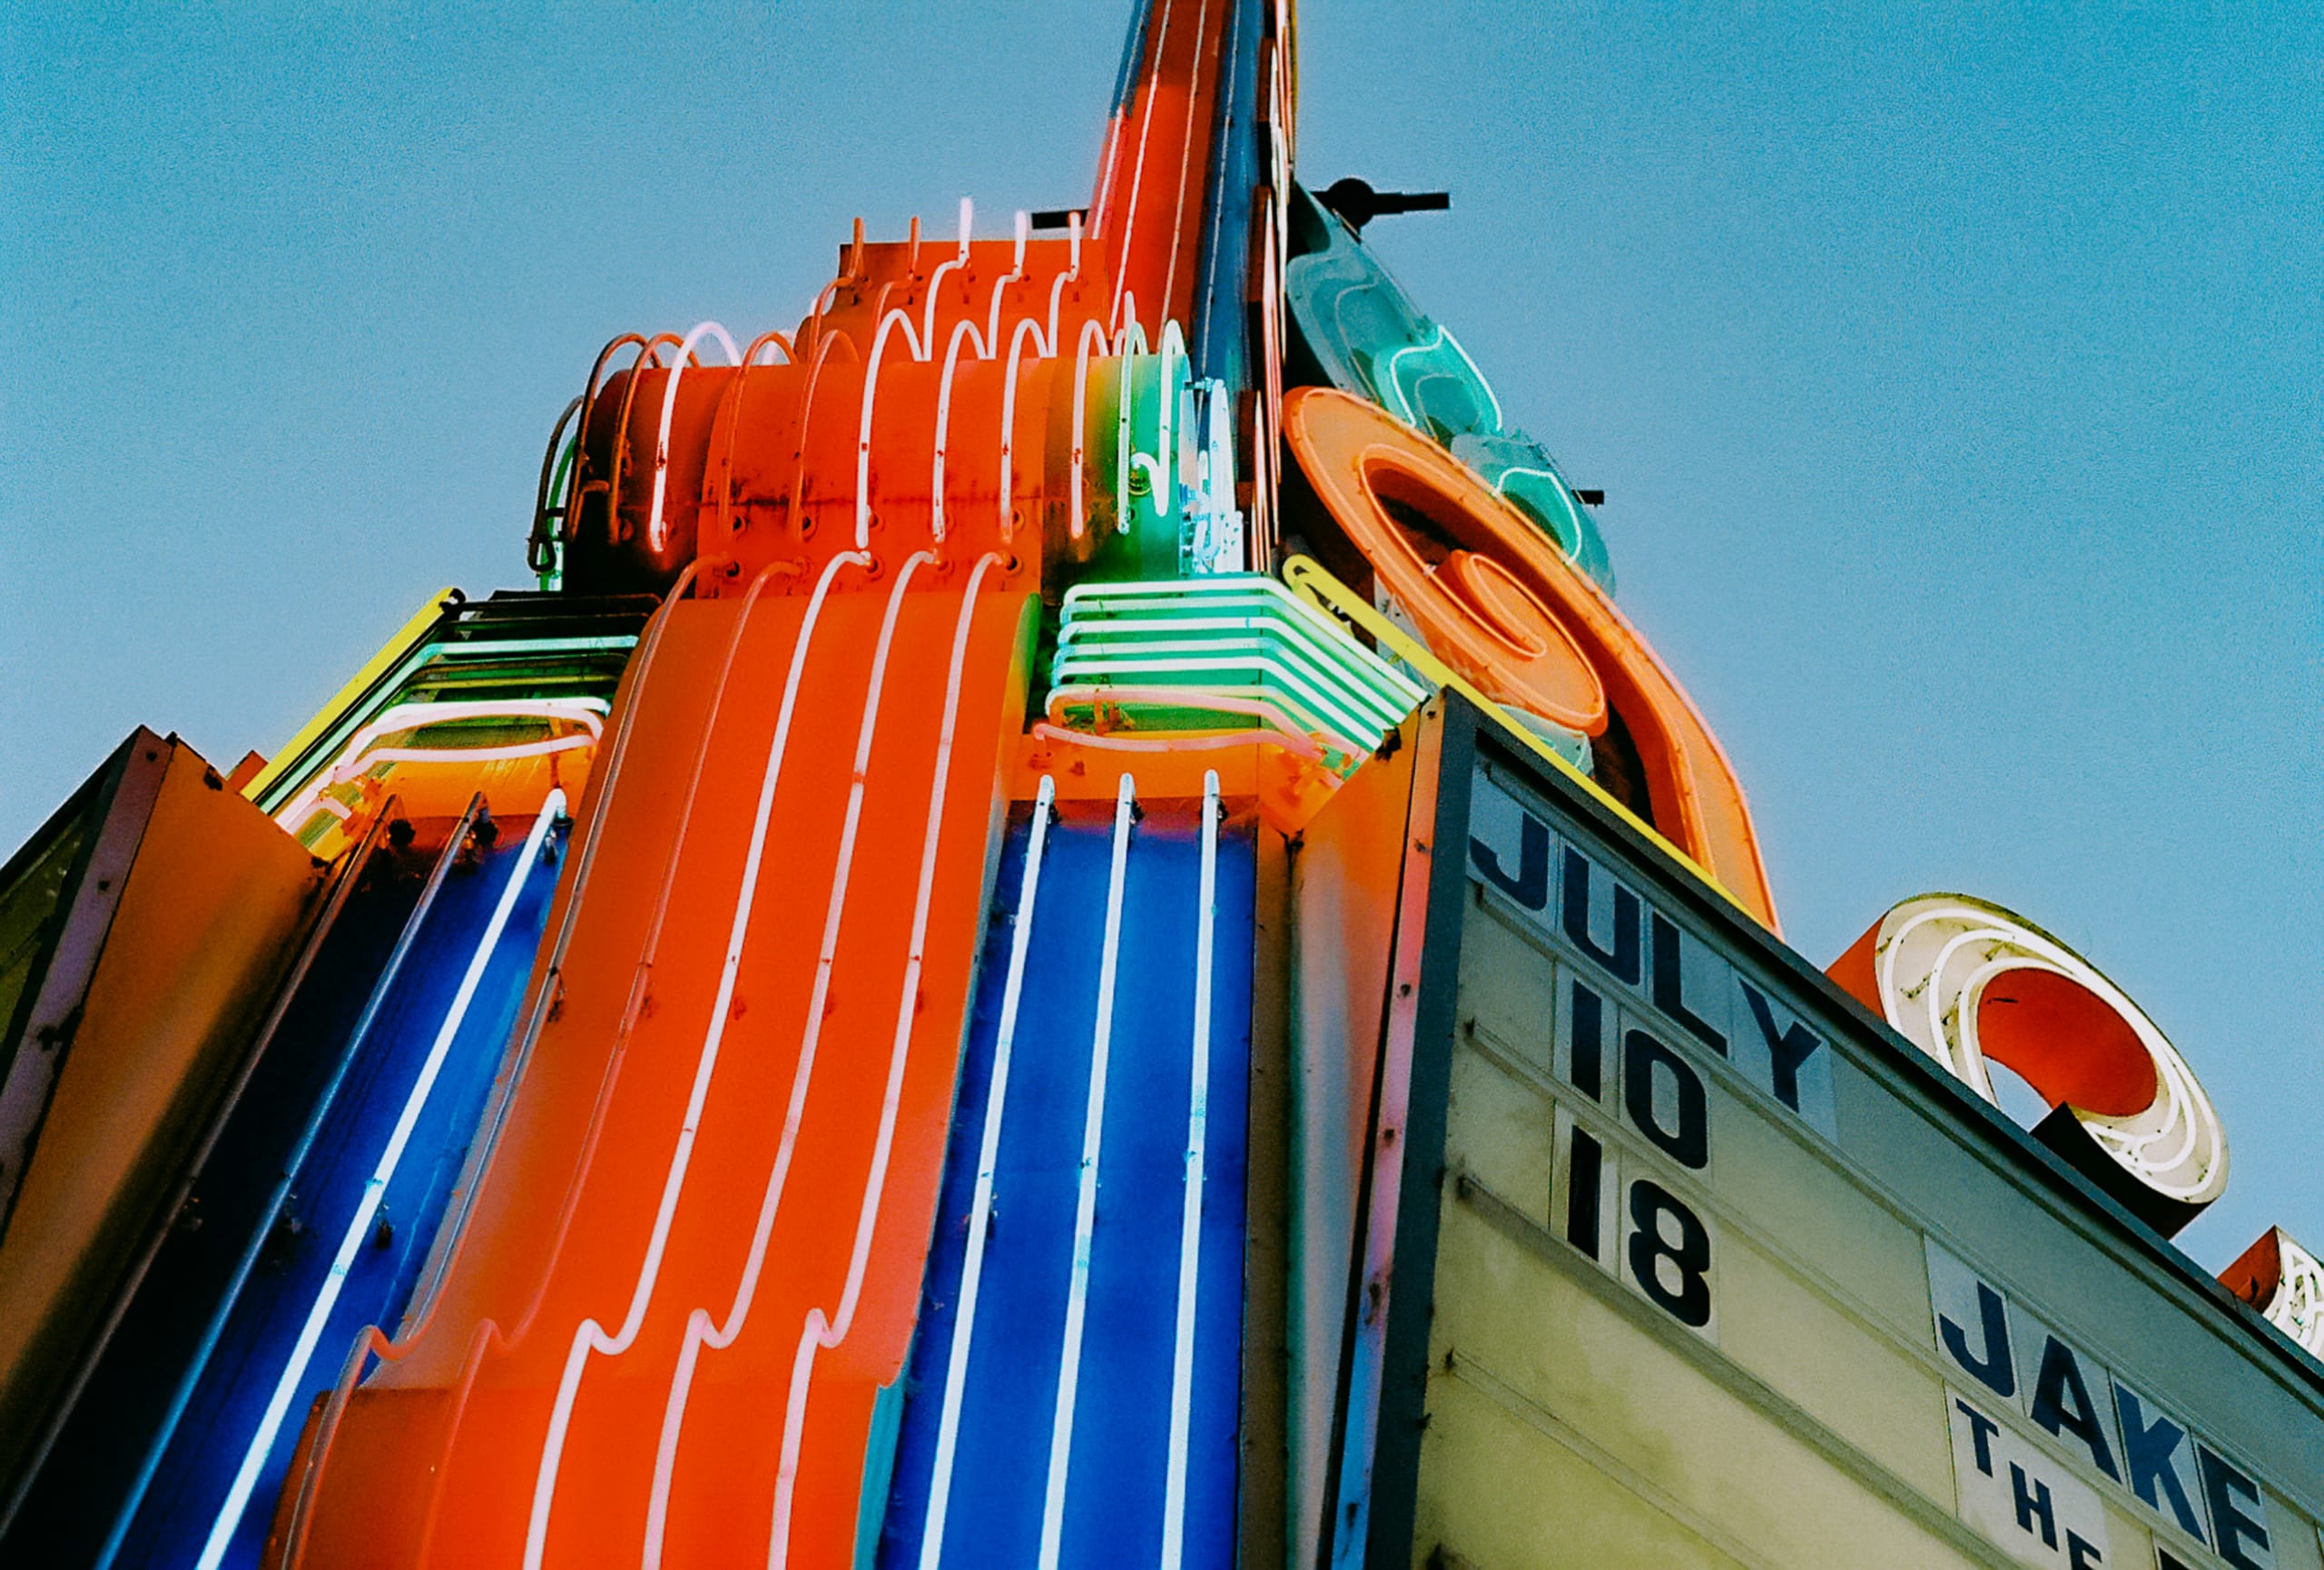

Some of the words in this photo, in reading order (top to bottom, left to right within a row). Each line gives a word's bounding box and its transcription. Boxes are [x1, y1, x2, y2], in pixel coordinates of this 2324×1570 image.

[1470, 812, 1822, 1114] JULY
[1571, 979, 1709, 1170] 10
[1568, 1124, 1710, 1328] 18
[1938, 1279, 2271, 1570] JAKE
